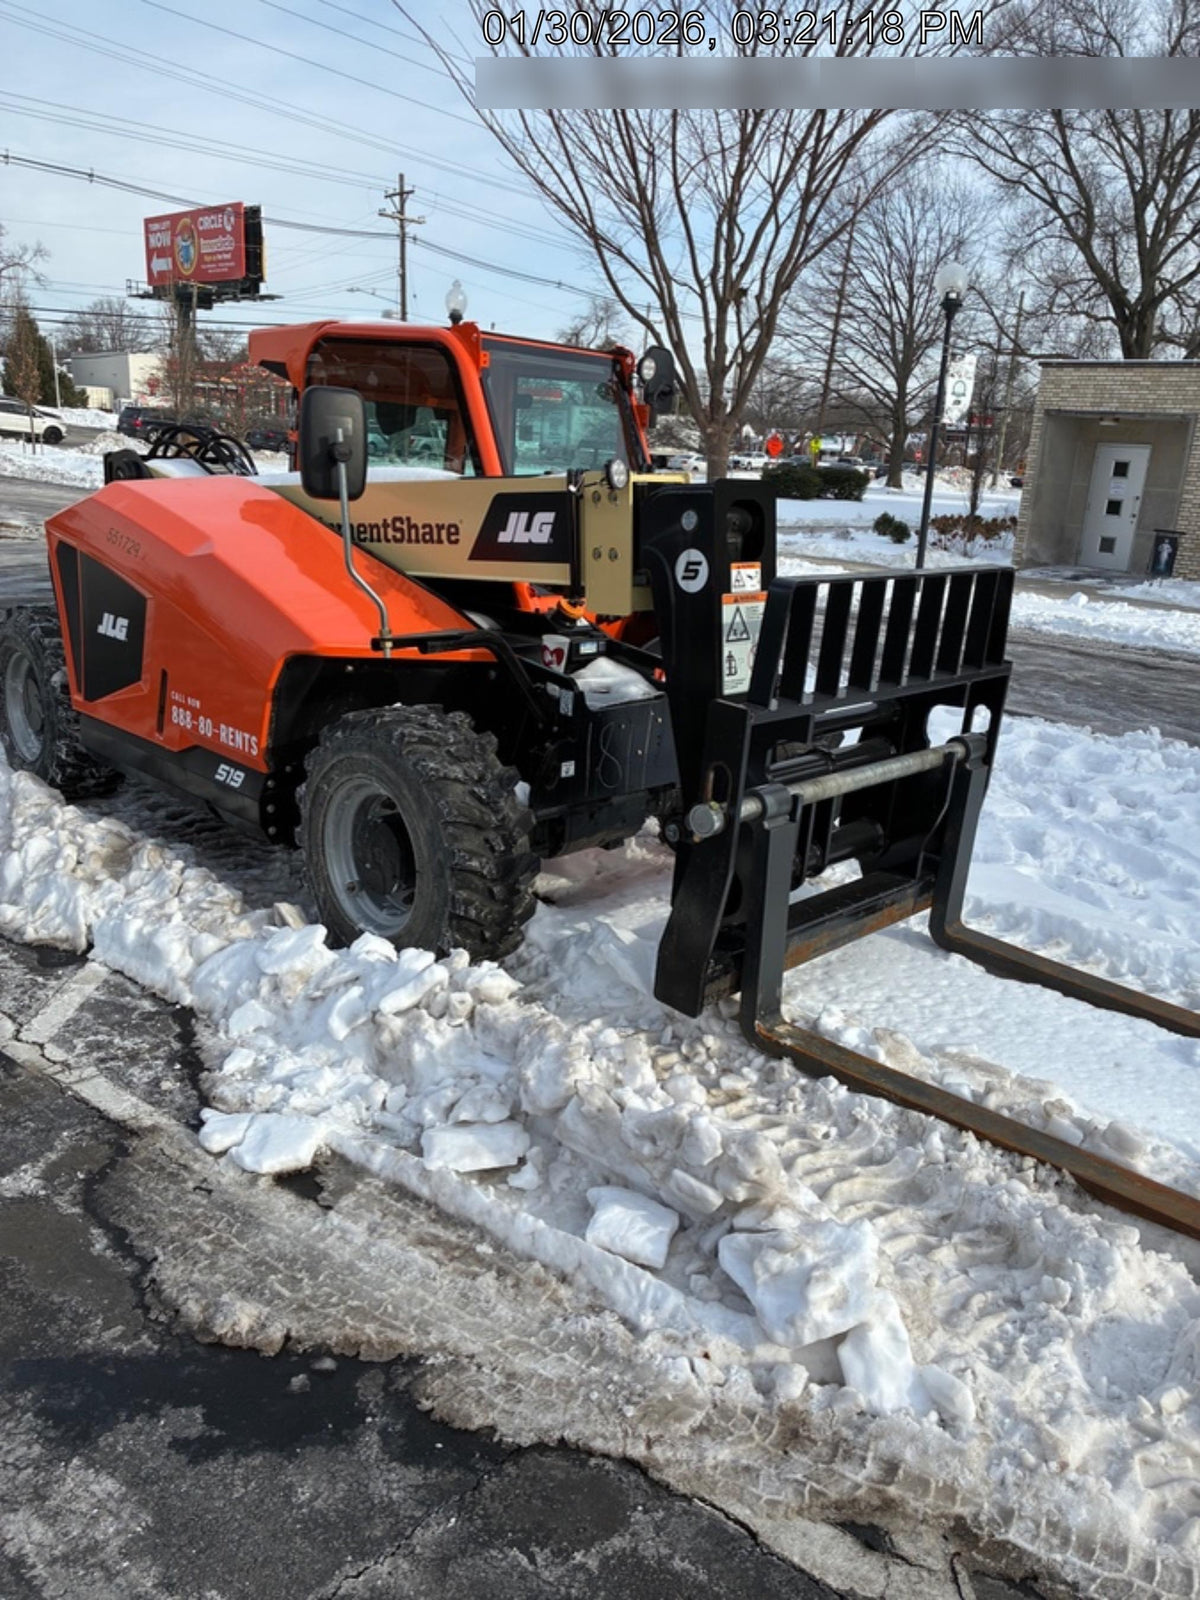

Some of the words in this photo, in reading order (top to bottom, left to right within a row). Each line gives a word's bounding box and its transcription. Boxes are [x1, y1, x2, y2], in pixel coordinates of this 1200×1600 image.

[198, 213, 223, 230] CIRCLE
[148, 230, 171, 249] NOW
[497, 511, 556, 544] JLG
[97, 611, 129, 641] JLG
[171, 705, 259, 756] 888-80-RENTS
